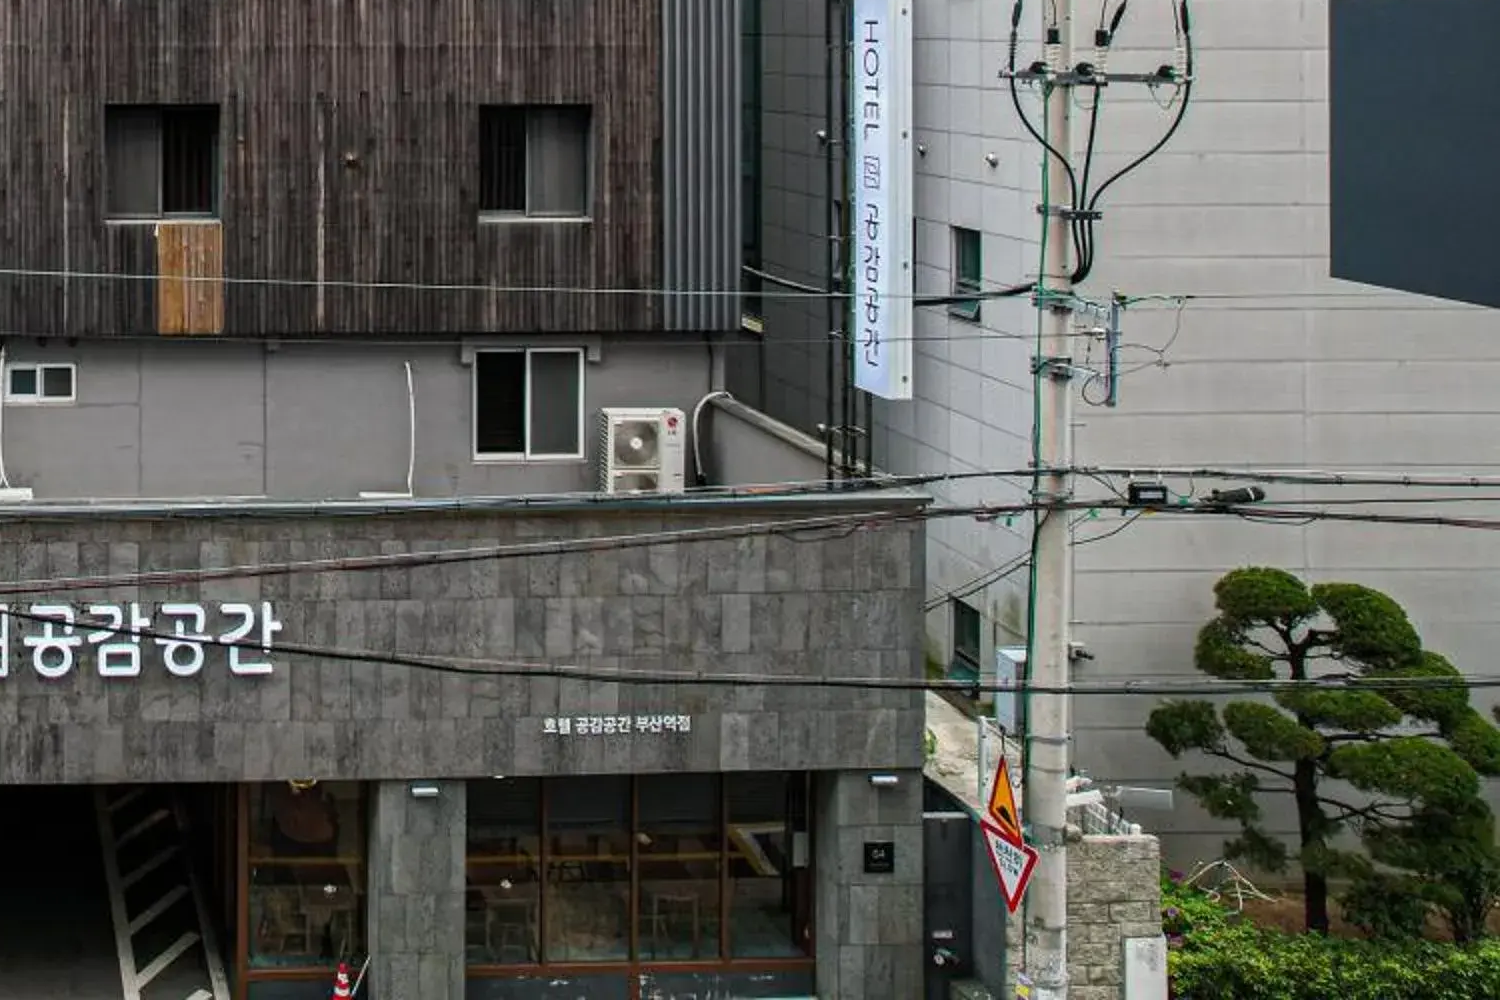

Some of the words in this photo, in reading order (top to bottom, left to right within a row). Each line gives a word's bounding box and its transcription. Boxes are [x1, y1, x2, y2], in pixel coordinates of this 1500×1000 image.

[863, 20, 880, 140] HOTEL
[23, 602, 283, 679] 공감공간
[543, 717, 571, 735] 호텔
[575, 716, 631, 735] 공감공간
[635, 715, 691, 733] 부산역점
